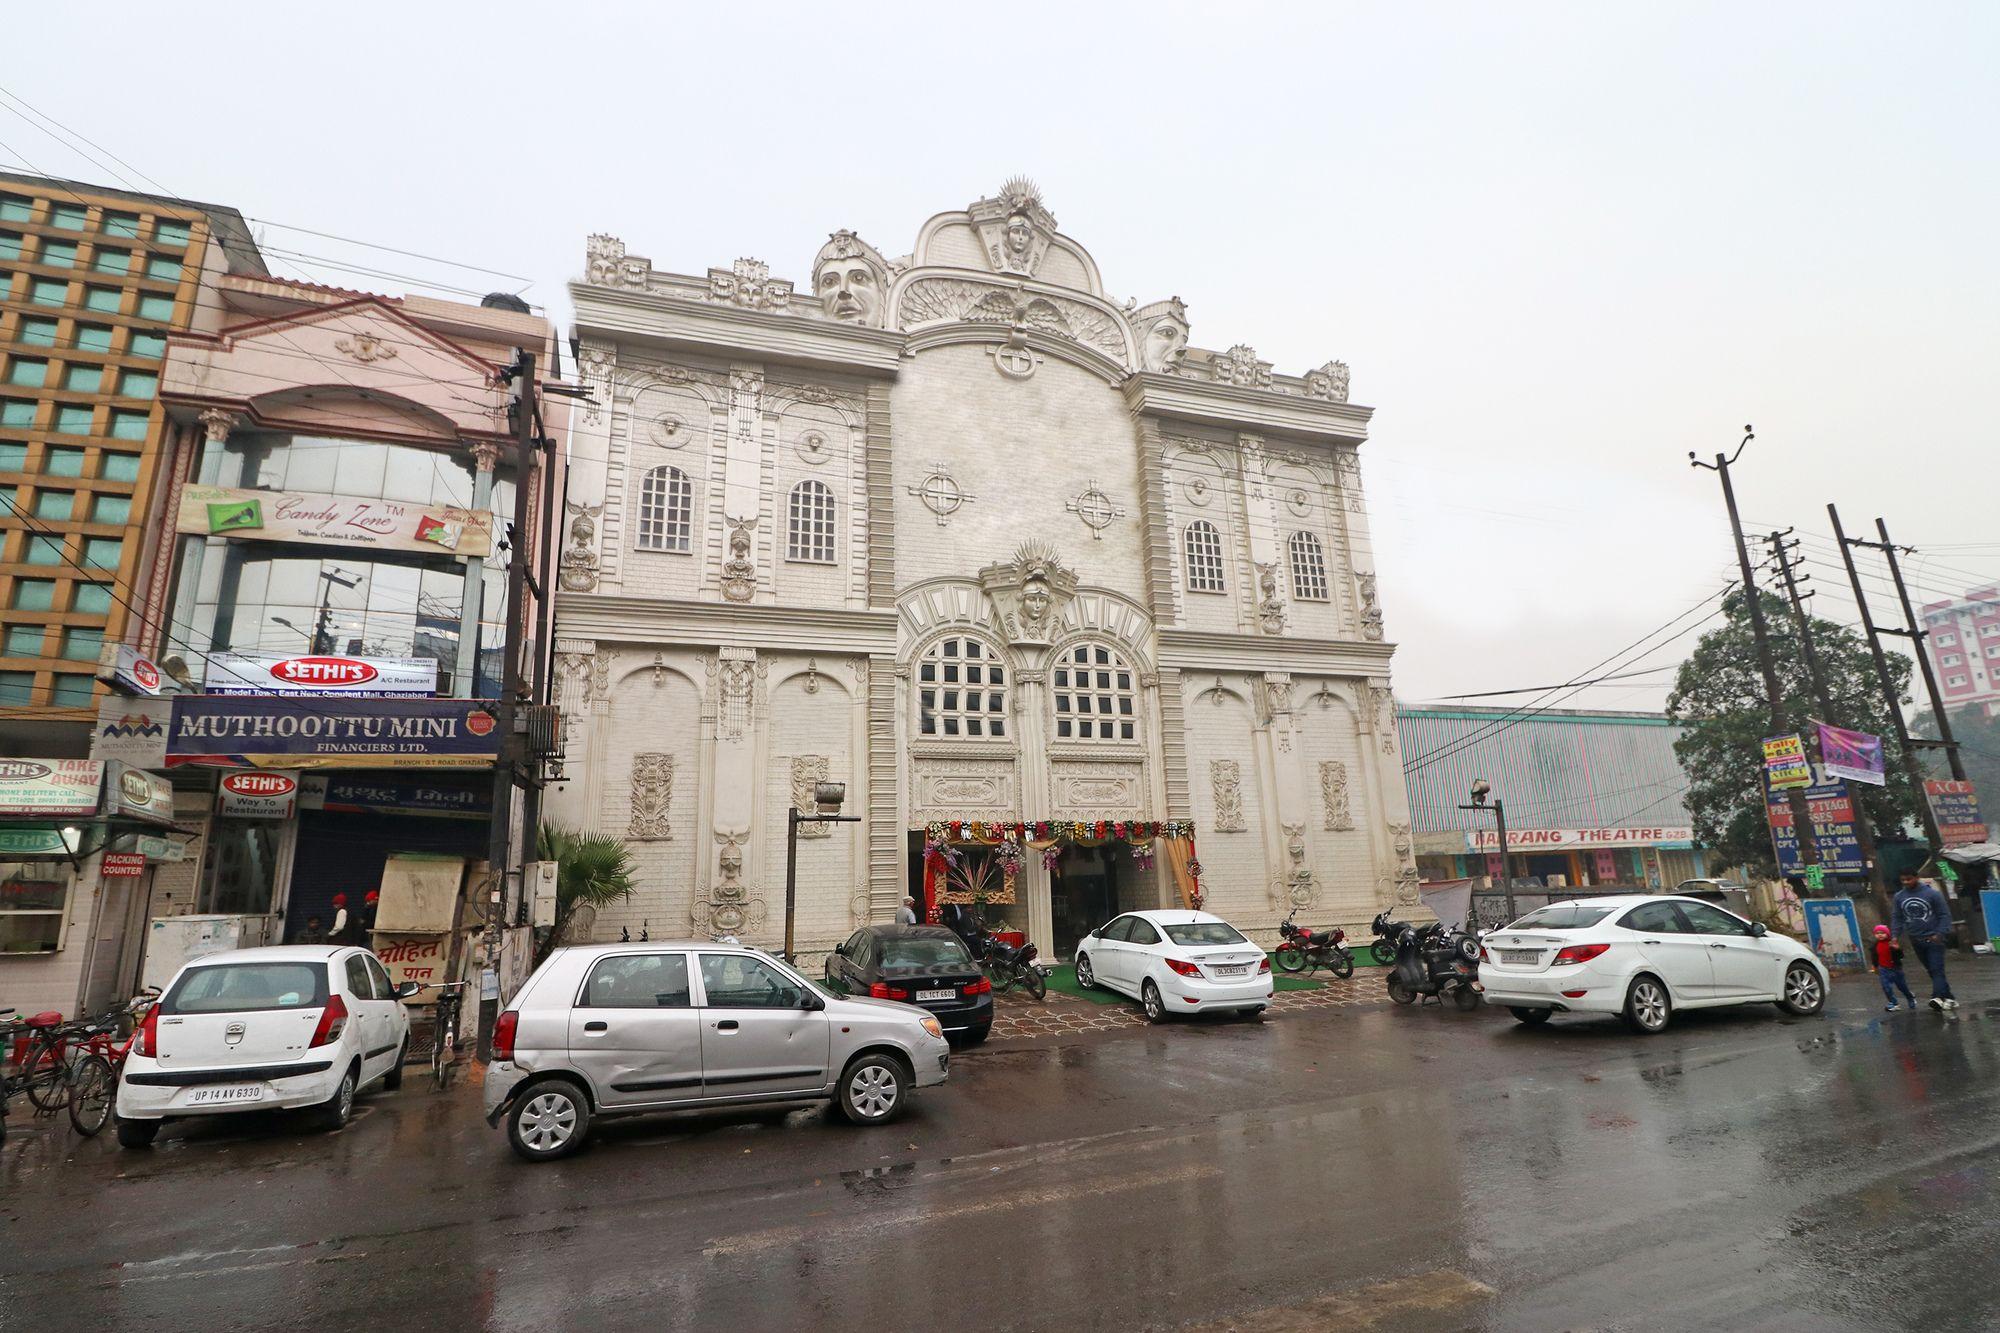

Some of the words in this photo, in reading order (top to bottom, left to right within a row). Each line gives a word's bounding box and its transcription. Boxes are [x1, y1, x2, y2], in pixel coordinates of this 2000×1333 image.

[275, 498, 341, 530] Candy
[346, 504, 397, 535] Zone
[283, 660, 364, 680] SETHI'S
[394, 677, 430, 685] Restaurant
[224, 688, 251, 697] Model
[278, 689, 300, 698] East
[384, 692, 429, 700] Ghaziabad
[178, 714, 382, 738] MUTHOOTTU
[388, 717, 458, 739] MINI
[317, 743, 395, 752] FINANCIERS
[399, 743, 428, 752] LTD.
[1765, 740, 1797, 750] Tally
[57, 760, 98, 772] TAKE
[50, 774, 99, 786] AWAY
[233, 776, 287, 791] SETHI'S
[1936, 781, 1970, 793] ACE
[237, 798, 260, 808] Way
[264, 797, 276, 806] To
[1820, 799, 1849, 812] TYAGI
[225, 806, 286, 816] Restaurant
[1577, 828, 1662, 842] THEATRE
[1814, 824, 1853, 837] M.Com
[1837, 836, 1858, 846] CMA
[105, 854, 143, 865] PACKING
[103, 866, 142, 876] COUNTER
[377, 940, 439, 963] मोहित
[403, 967, 434, 980] पान
[194, 1090, 207, 1101] UP
[210, 1090, 220, 1100] 14
[222, 1089, 235, 1099] AV
[236, 1087, 260, 1098] 6330
